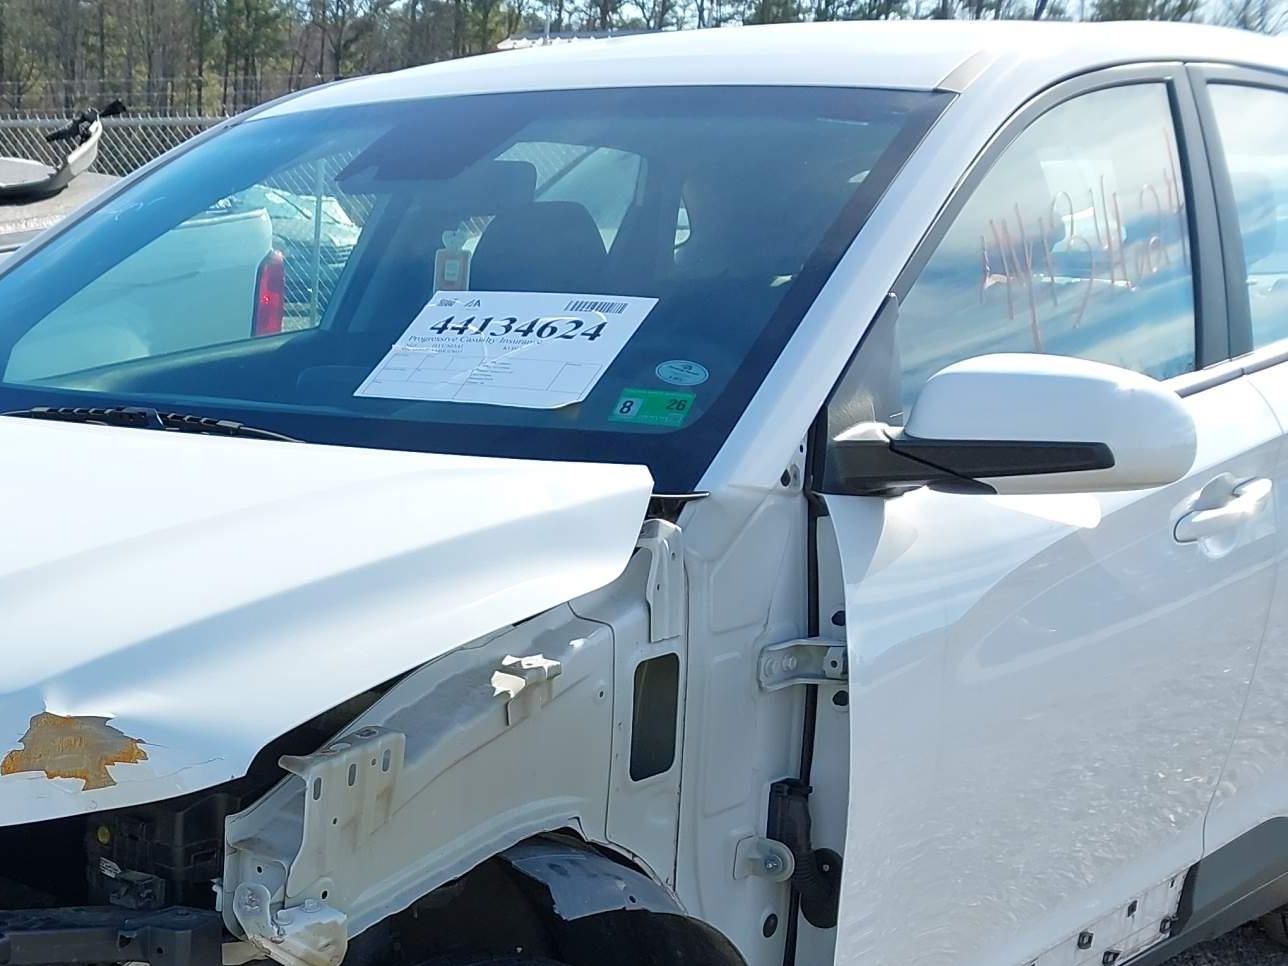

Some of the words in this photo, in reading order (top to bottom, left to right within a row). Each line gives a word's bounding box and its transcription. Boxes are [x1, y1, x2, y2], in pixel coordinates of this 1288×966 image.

[430, 315, 607, 342] 44134624
[619, 400, 633, 414] 8
[665, 399, 688, 411] 26
